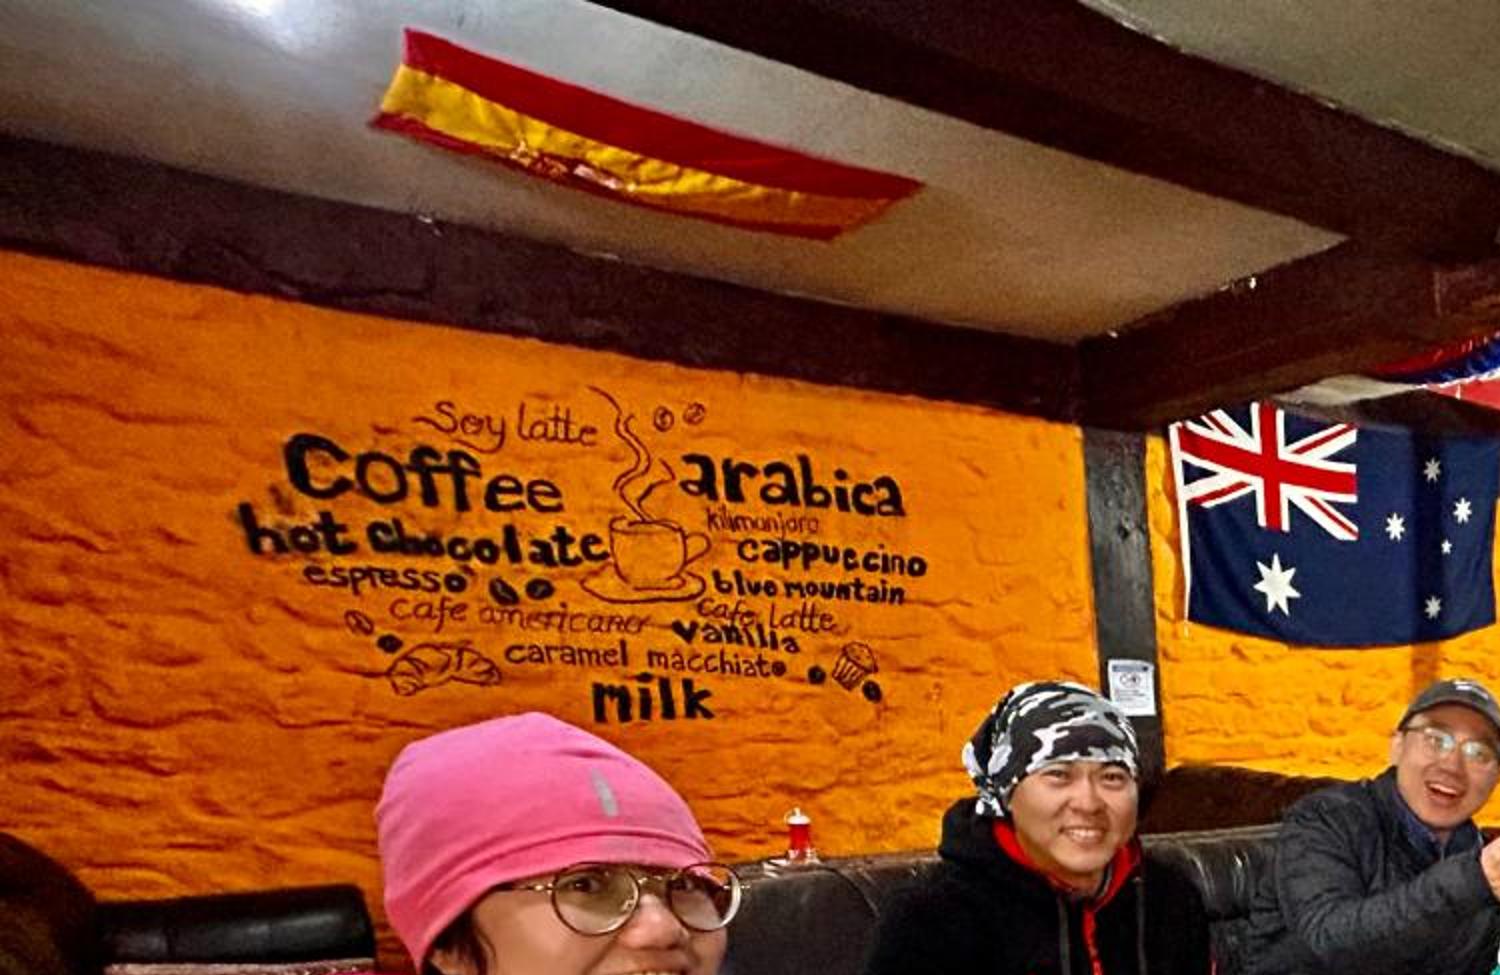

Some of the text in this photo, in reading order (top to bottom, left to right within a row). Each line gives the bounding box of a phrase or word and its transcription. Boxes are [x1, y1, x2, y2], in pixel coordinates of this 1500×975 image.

[412, 401, 597, 454] Soy latte
[282, 432, 564, 512] Coffee
[680, 453, 905, 517] arabica
[237, 501, 610, 567] hot chocolate
[304, 564, 468, 596] espresso
[737, 538, 927, 578] cappuccino
[712, 570, 905, 605] blue mountain
[505, 639, 786, 679] caramel macchiato
[672, 618, 801, 654] vanilla
[592, 671, 715, 723] milk
